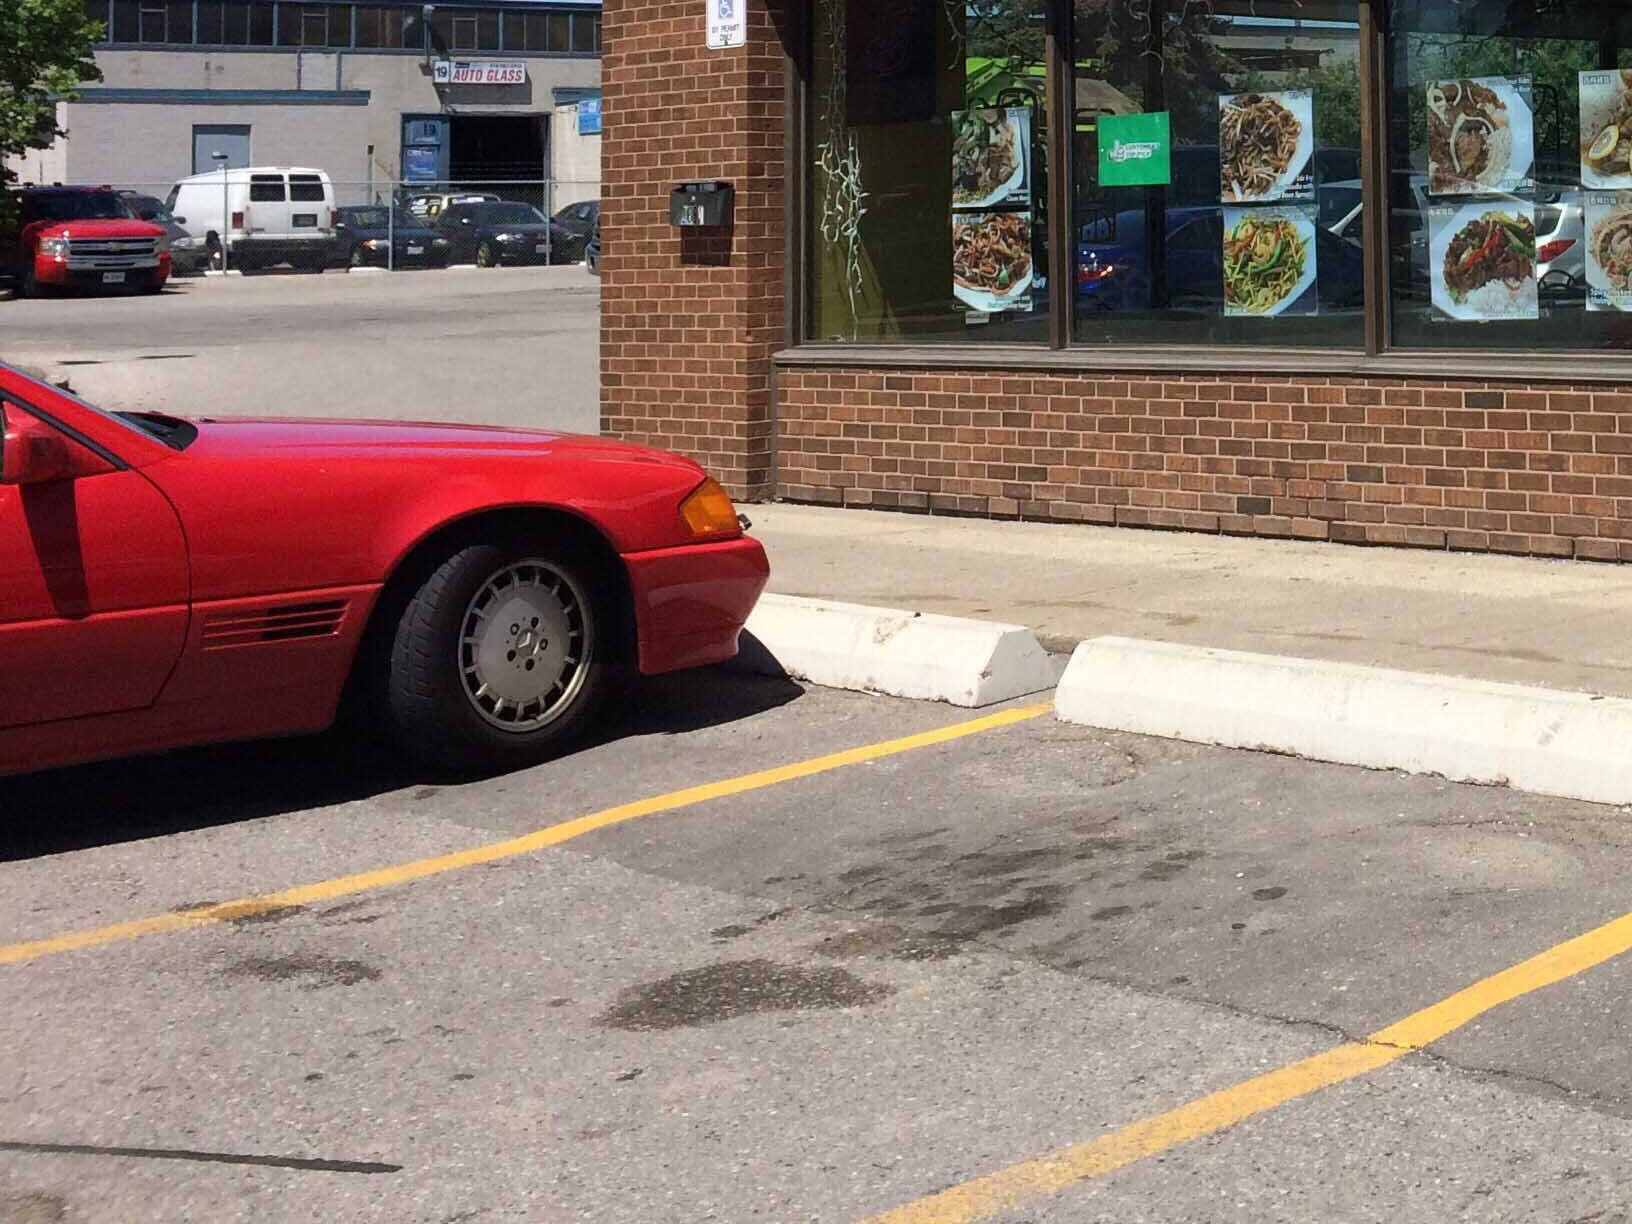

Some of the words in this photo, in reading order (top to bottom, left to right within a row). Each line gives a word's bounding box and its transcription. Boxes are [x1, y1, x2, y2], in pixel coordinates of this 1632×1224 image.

[435, 65, 448, 78] 19
[452, 69, 483, 82] AUTO
[486, 69, 523, 82] GLASS
